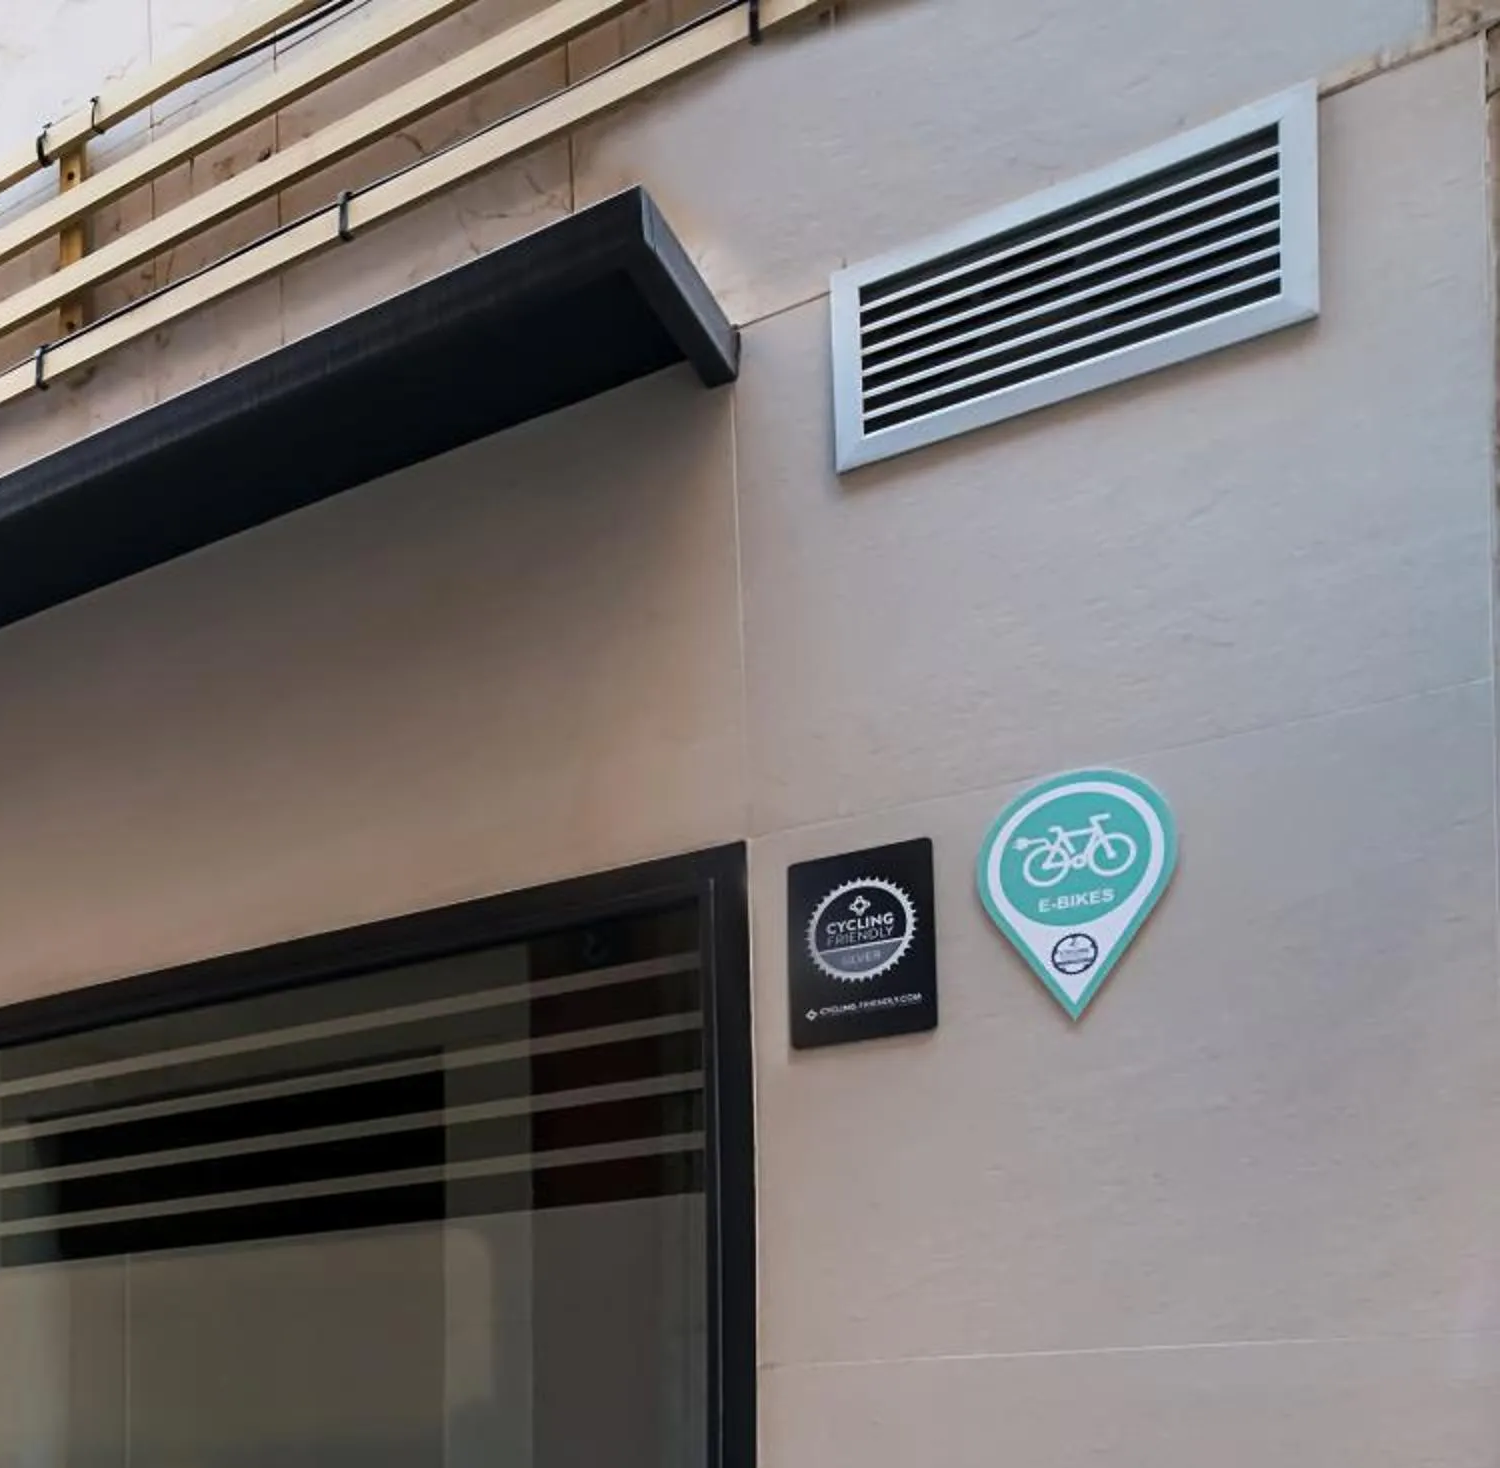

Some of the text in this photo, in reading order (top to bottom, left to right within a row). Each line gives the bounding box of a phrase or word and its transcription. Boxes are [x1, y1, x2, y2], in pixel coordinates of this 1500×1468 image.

[1038, 888, 1115, 913] E-BIKES
[826, 911, 895, 935] CYCLING
[827, 925, 894, 947] FRIENDLY
